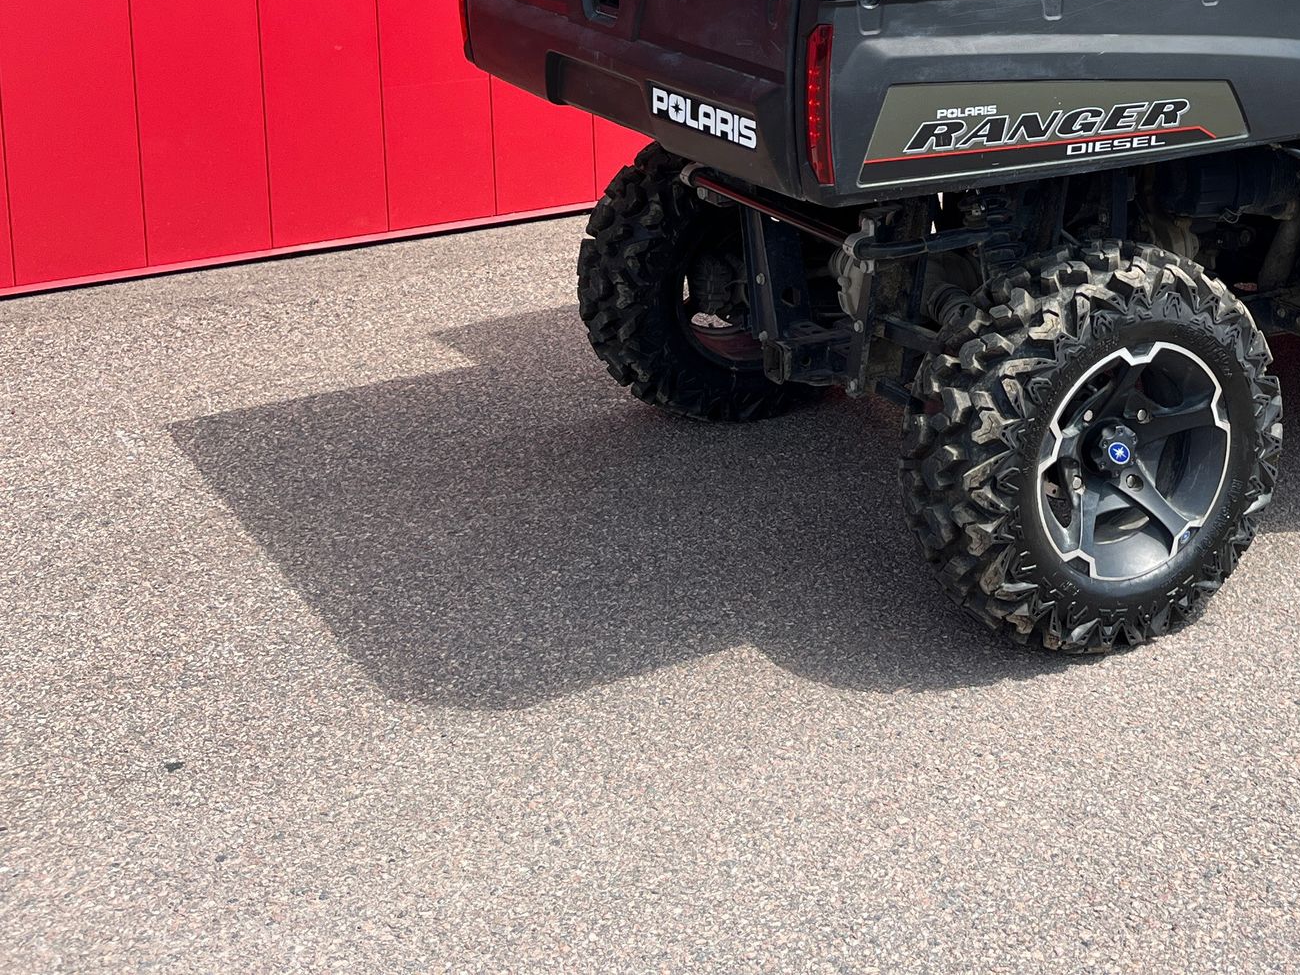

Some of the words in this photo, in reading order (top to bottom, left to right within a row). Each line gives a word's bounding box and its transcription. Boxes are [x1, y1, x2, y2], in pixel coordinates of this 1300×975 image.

[652, 87, 757, 149] POLARIS
[903, 98, 1191, 154] RANGER
[937, 105, 997, 119] POLARIS
[1066, 135, 1165, 156] DIESEL
